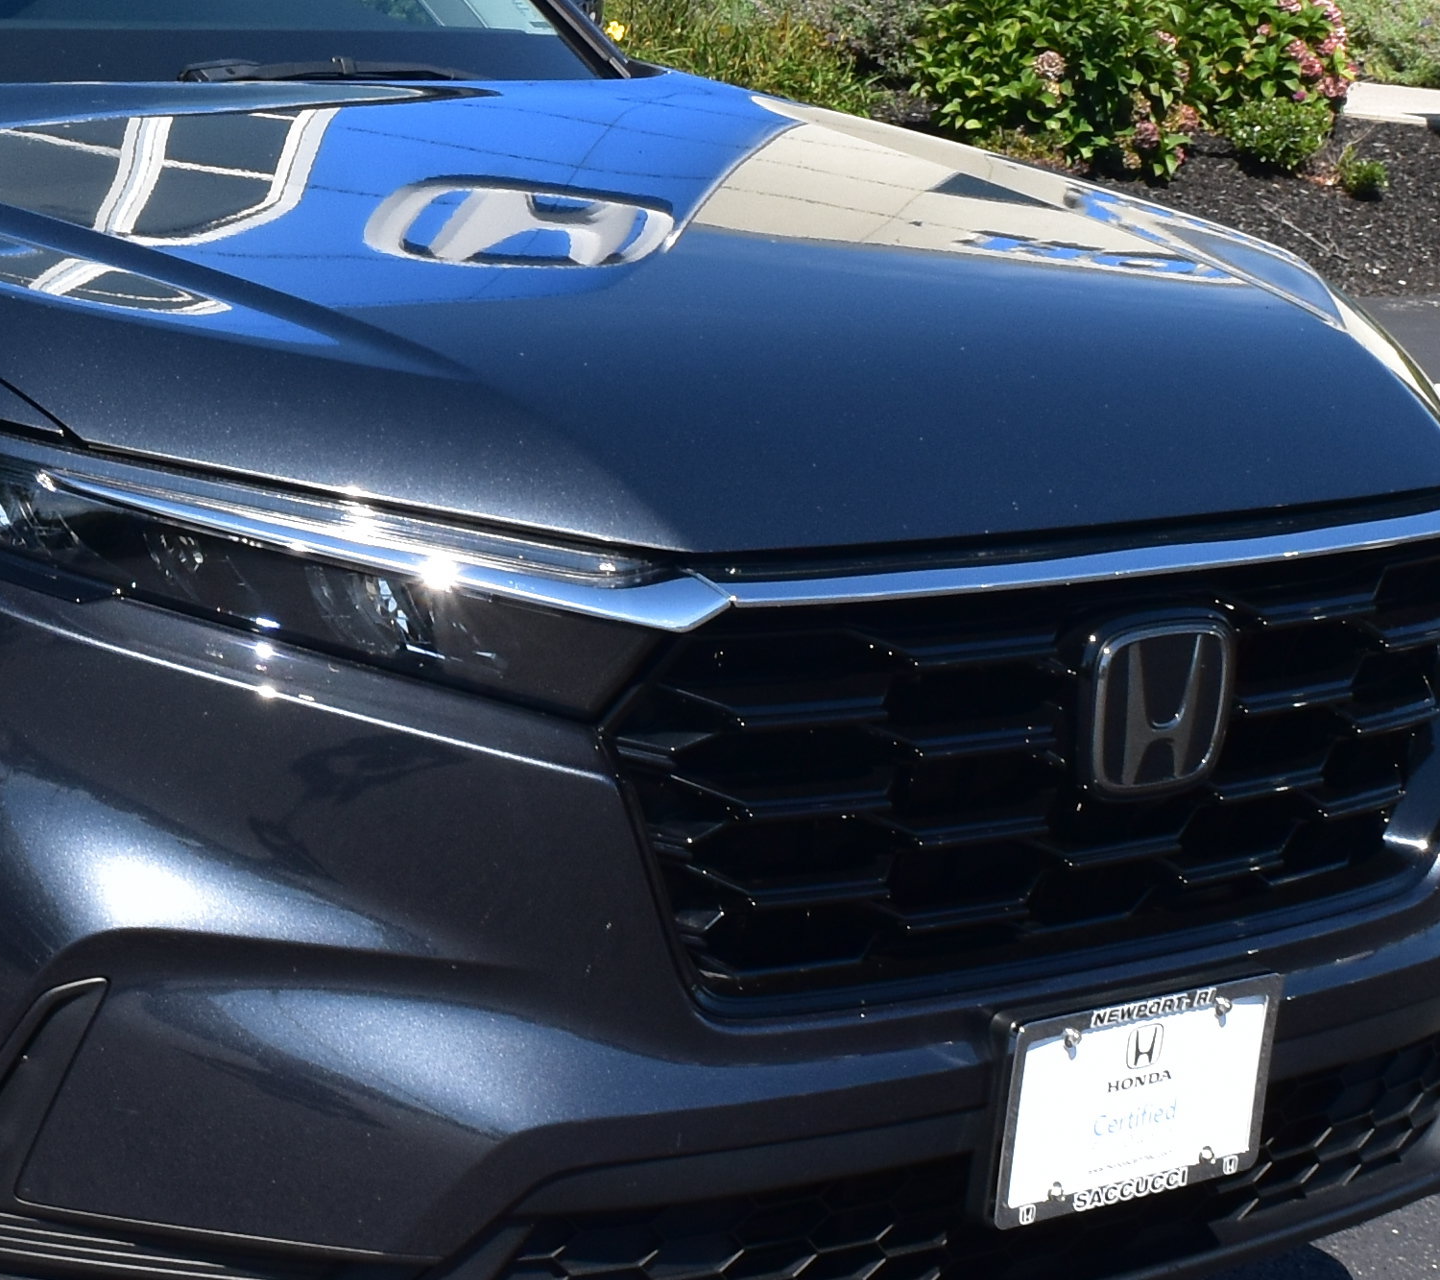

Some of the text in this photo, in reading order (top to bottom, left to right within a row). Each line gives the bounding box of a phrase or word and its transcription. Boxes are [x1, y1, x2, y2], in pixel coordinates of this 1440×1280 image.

[1194, 987, 1217, 1006] RI
[1107, 1070, 1172, 1093] HONDA
[1092, 1098, 1177, 1137] Certified
[1073, 1167, 1189, 1211] SACCUCCI
